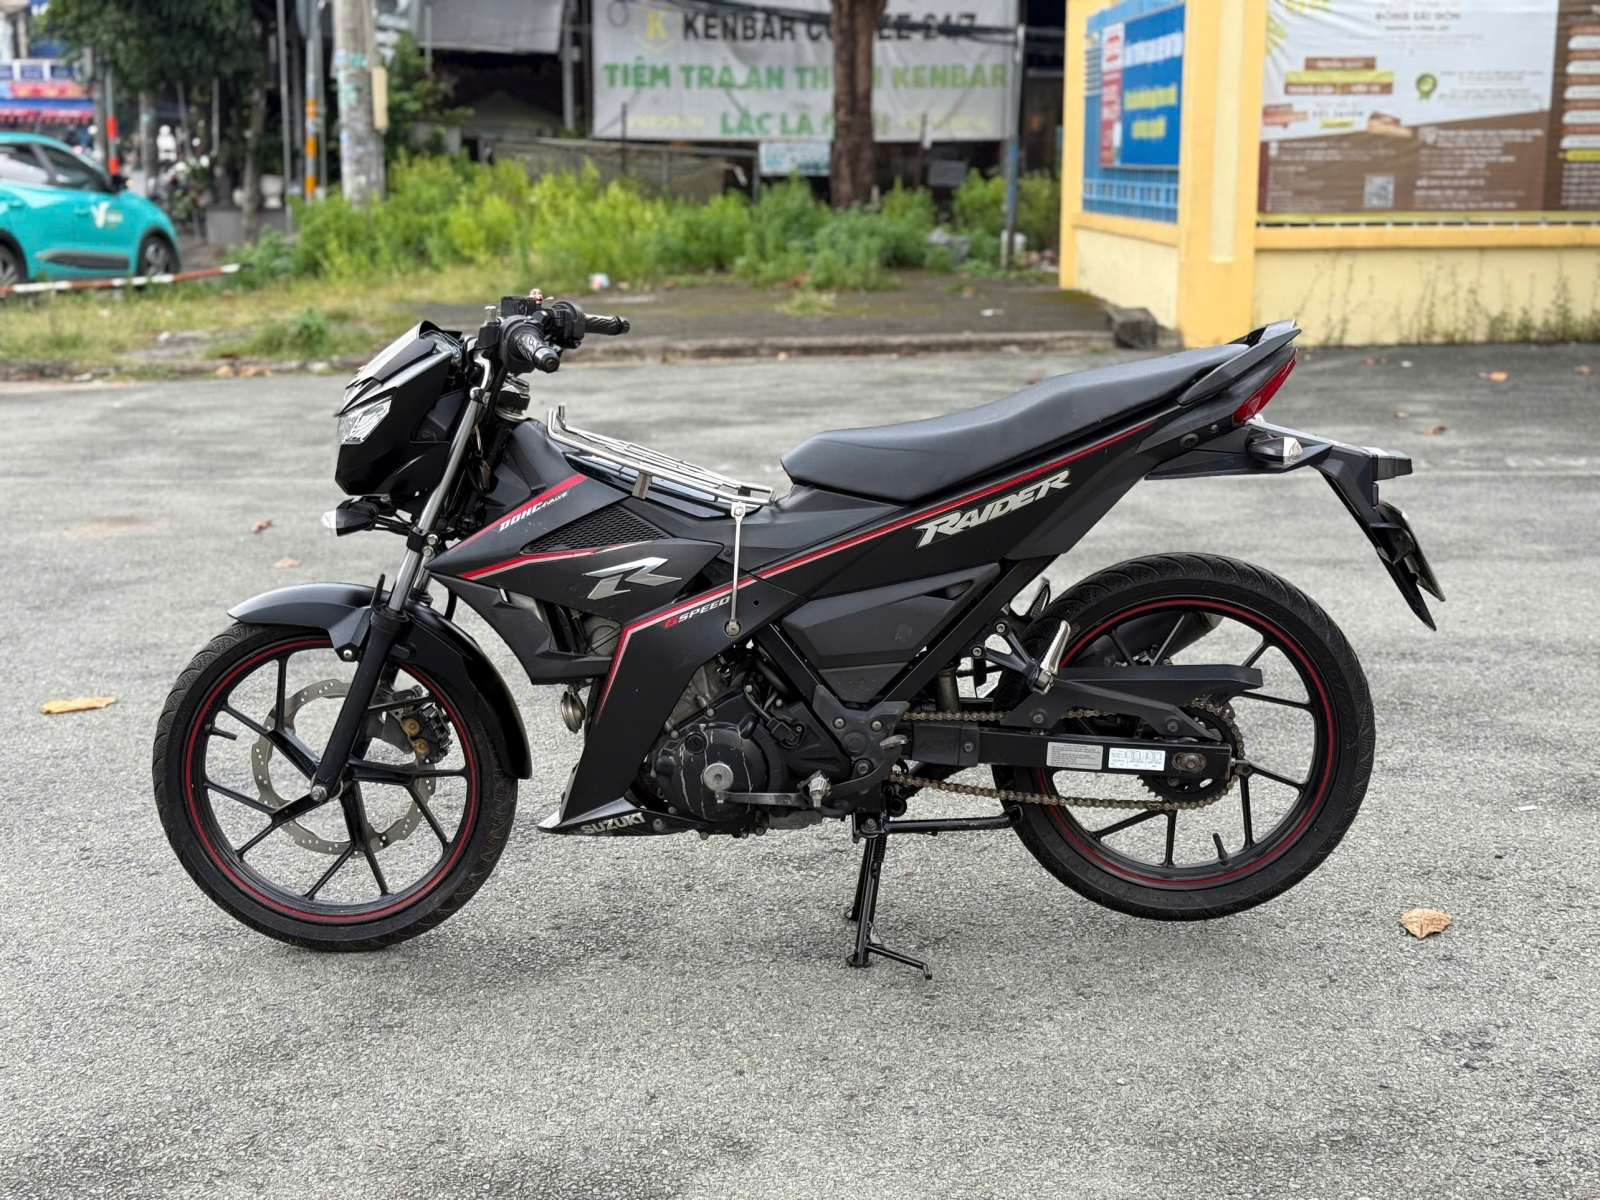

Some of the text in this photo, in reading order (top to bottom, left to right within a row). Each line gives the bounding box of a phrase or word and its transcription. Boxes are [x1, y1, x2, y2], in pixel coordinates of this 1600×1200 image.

[683, 12, 796, 41] KENBAR
[603, 55, 671, 95] TIỆM
[892, 63, 1007, 89] KENBAR
[498, 501, 543, 532] DOHC
[912, 468, 1072, 549] RAIDER
[580, 811, 646, 835] SUZUKI
